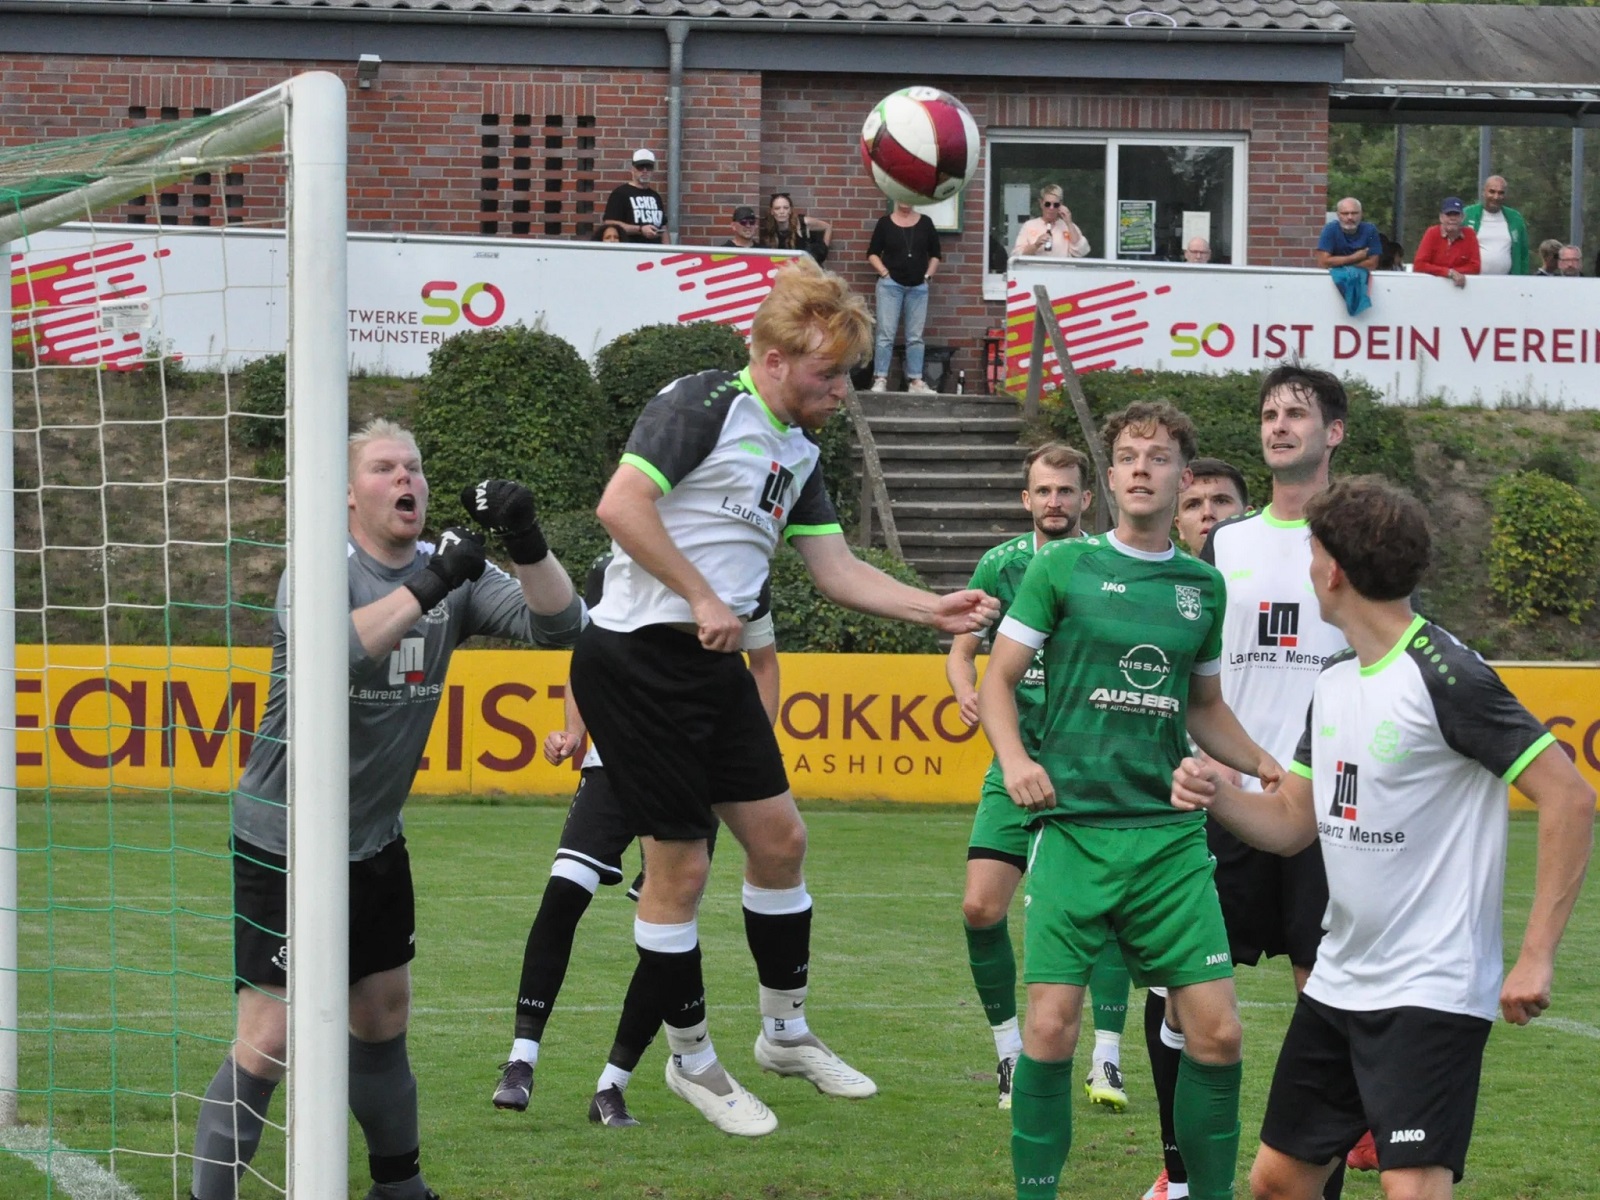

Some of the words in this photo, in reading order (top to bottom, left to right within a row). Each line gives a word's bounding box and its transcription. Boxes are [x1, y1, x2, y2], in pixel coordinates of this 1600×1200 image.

[421, 281, 505, 327] SO
[1170, 322, 1235, 358] SO
[1252, 323, 1314, 359] IST
[1334, 324, 1440, 361] DEIN
[1101, 581, 1126, 593] JAKO
[1119, 660, 1170, 673] NISSAN
[782, 754, 942, 775] ASHION
[1350, 825, 1405, 844] Mense
[1206, 952, 1228, 965] JAKO
[519, 997, 545, 1008] JAKO
[1100, 1003, 1125, 1012] JAKO
[1390, 1129, 1426, 1143] JAKO
[1021, 1175, 1055, 1187] JAKO
